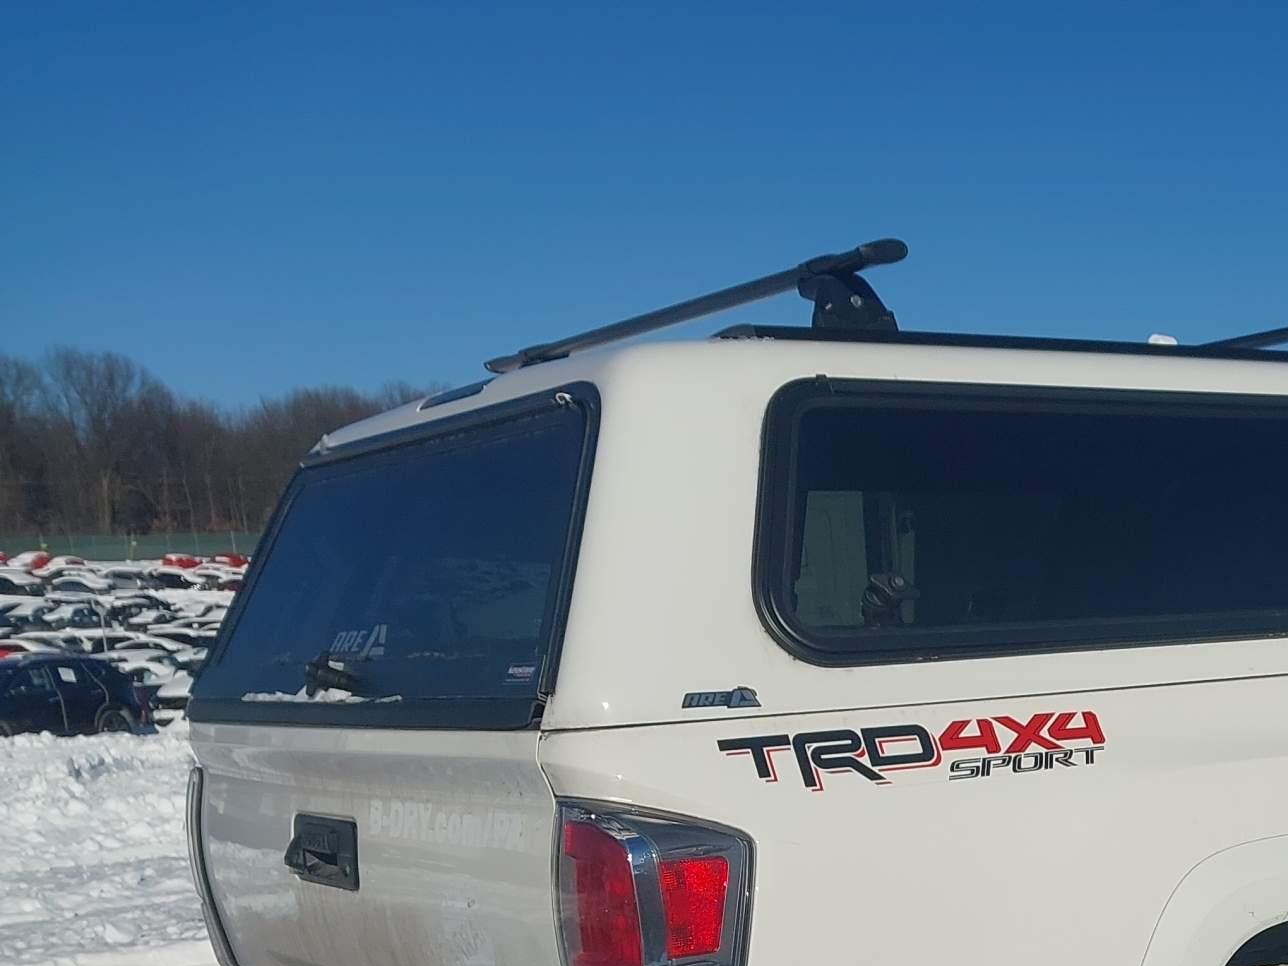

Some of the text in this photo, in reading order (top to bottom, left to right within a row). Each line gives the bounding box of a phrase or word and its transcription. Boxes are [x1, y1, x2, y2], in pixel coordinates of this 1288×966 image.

[717, 711, 1106, 792] TRD 4X4
[948, 746, 1105, 781] SPORT
